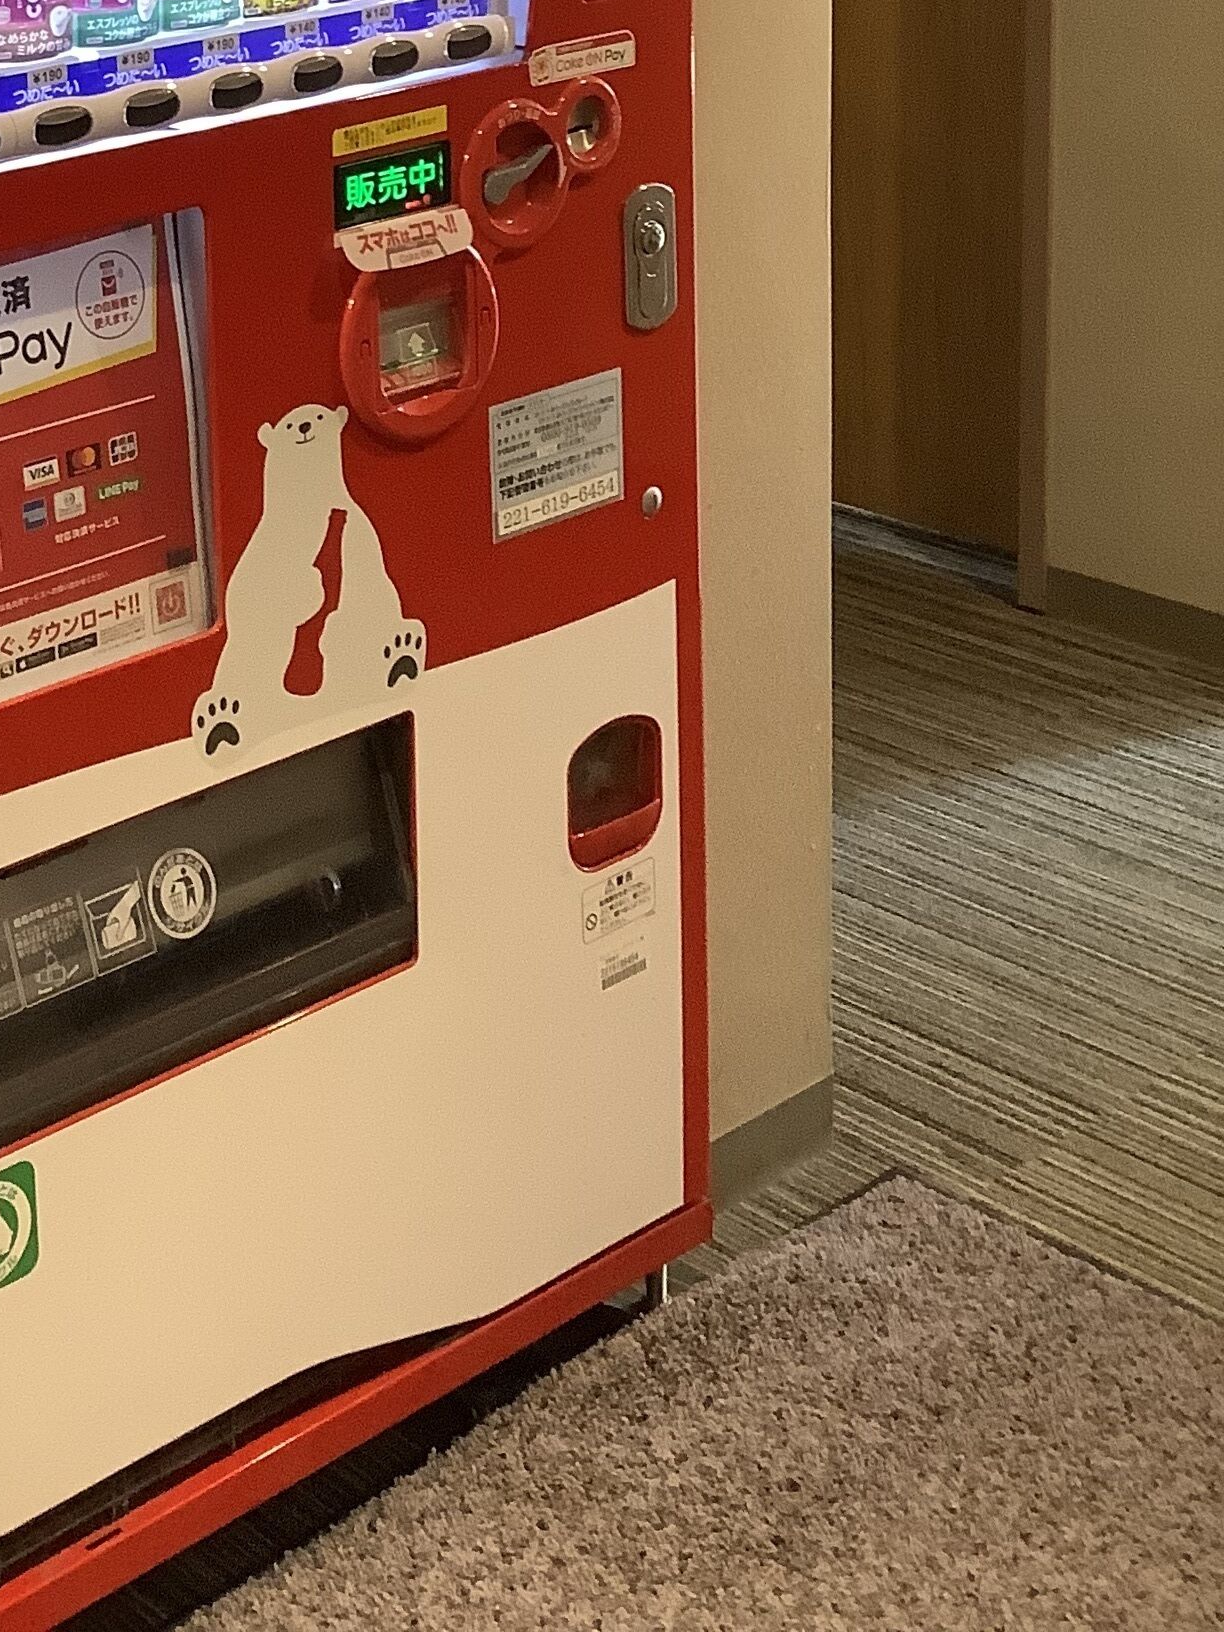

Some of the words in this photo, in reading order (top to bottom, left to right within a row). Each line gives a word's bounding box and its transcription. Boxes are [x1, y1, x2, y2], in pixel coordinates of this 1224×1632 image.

[87, 14, 138, 29] エスプレッソの
[207, 37, 235, 50] ¥190
[121, 51, 150, 65] ¥190
[604, 48, 626, 64] Pay
[33, 68, 63, 82] ¥190
[345, 158, 436, 210] 販売中
[357, 214, 457, 254] スマホはココへ!!
[29, 464, 55, 480] VISA
[98, 483, 122, 499] LINE
[122, 479, 139, 493] Pay
[503, 477, 615, 529] 221-619-6454
